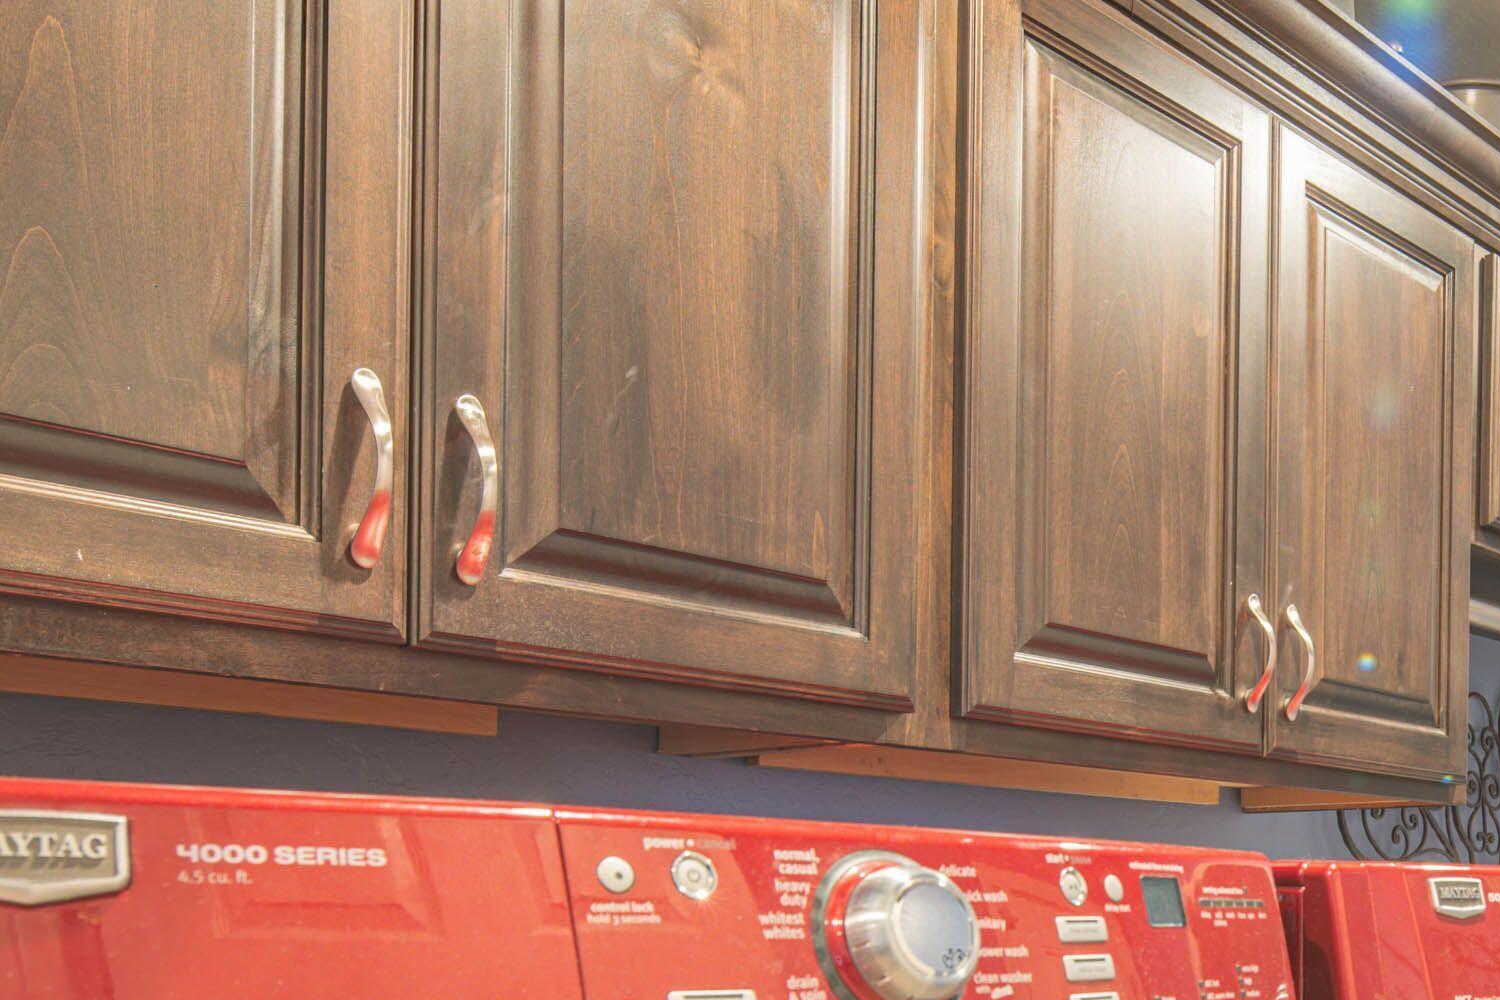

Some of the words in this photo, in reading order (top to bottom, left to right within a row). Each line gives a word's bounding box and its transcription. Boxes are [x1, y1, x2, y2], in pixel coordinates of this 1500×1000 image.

[643, 837, 685, 851] power
[176, 843, 268, 864] 4000
[273, 846, 388, 867] SERIES
[176, 869, 204, 884] 4.5
[779, 863, 818, 875] casual
[774, 877, 811, 896] heavy
[590, 901, 630, 913] control
[632, 901, 654, 913] lock
[780, 892, 808, 909] duty
[758, 911, 805, 926] whitest
[762, 925, 805, 940] whites
[787, 974, 820, 990] drain
